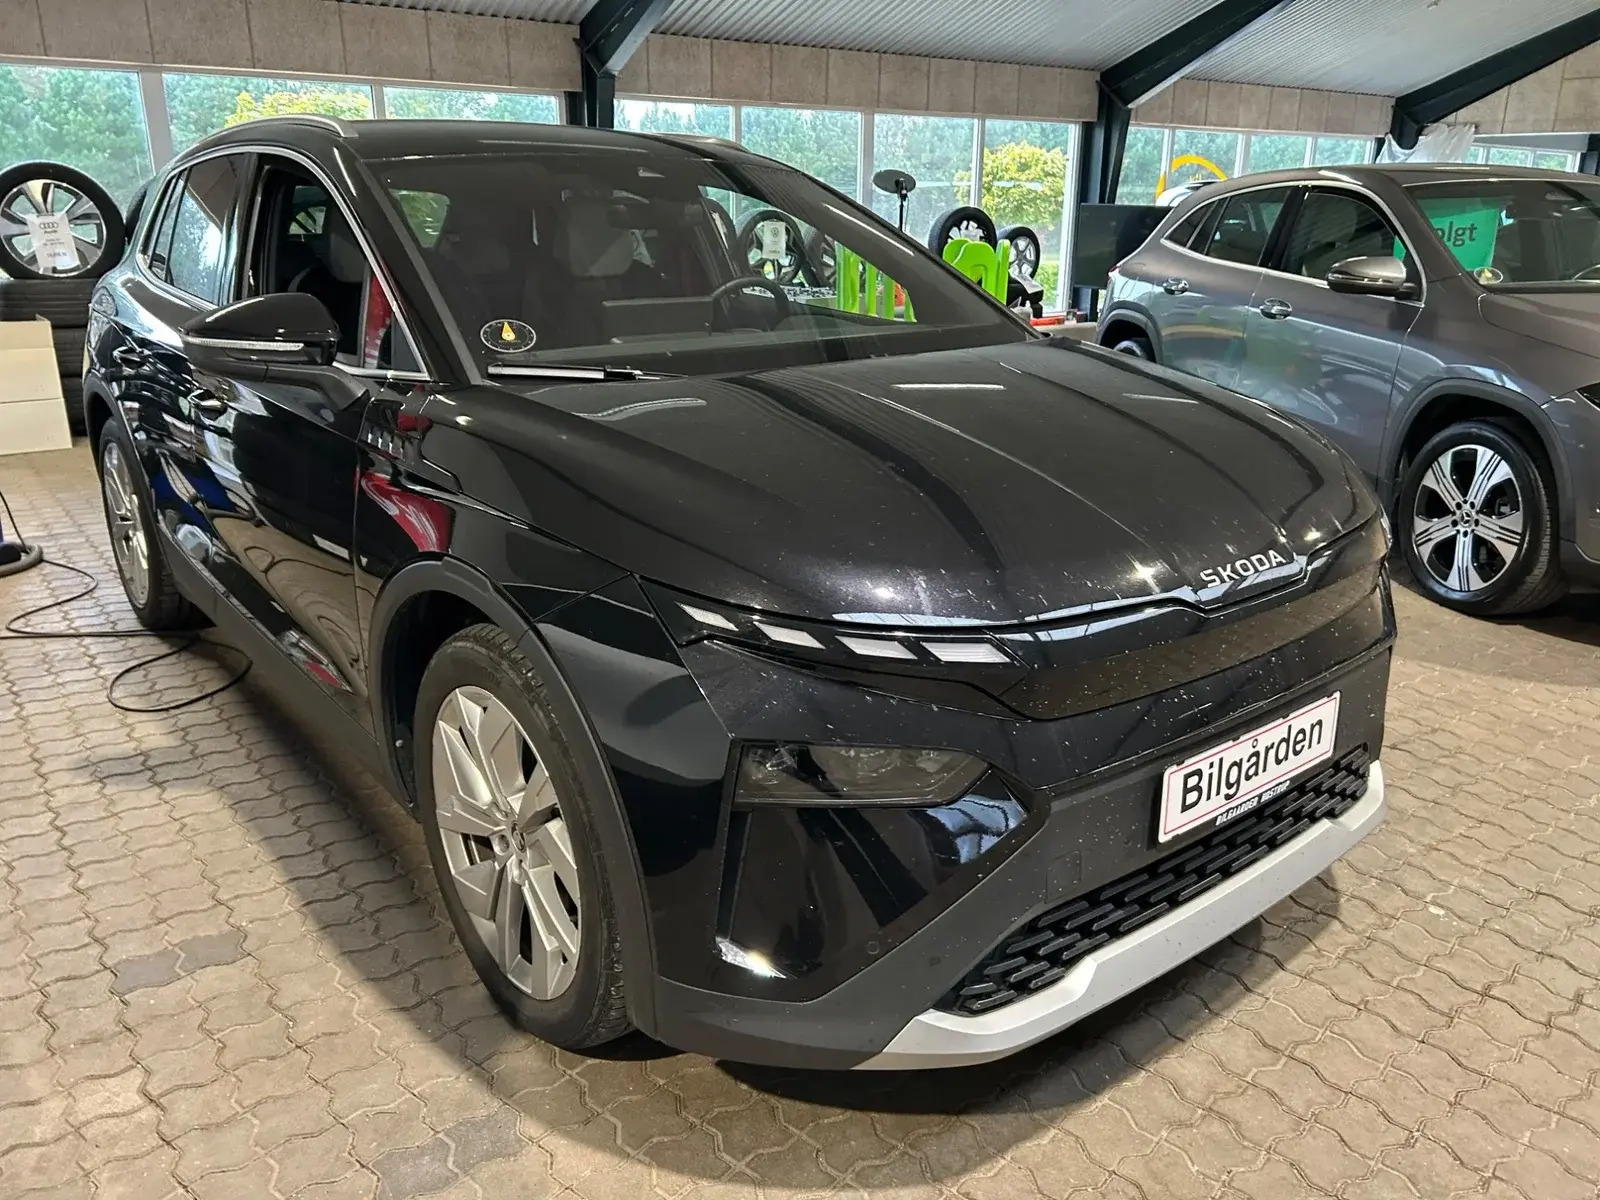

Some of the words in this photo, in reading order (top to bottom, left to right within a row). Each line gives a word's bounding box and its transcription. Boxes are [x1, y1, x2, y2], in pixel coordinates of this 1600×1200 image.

[1435, 221, 1478, 248] olgt
[1199, 549, 1287, 588] SKODA
[1180, 718, 1323, 814] Bilgården
